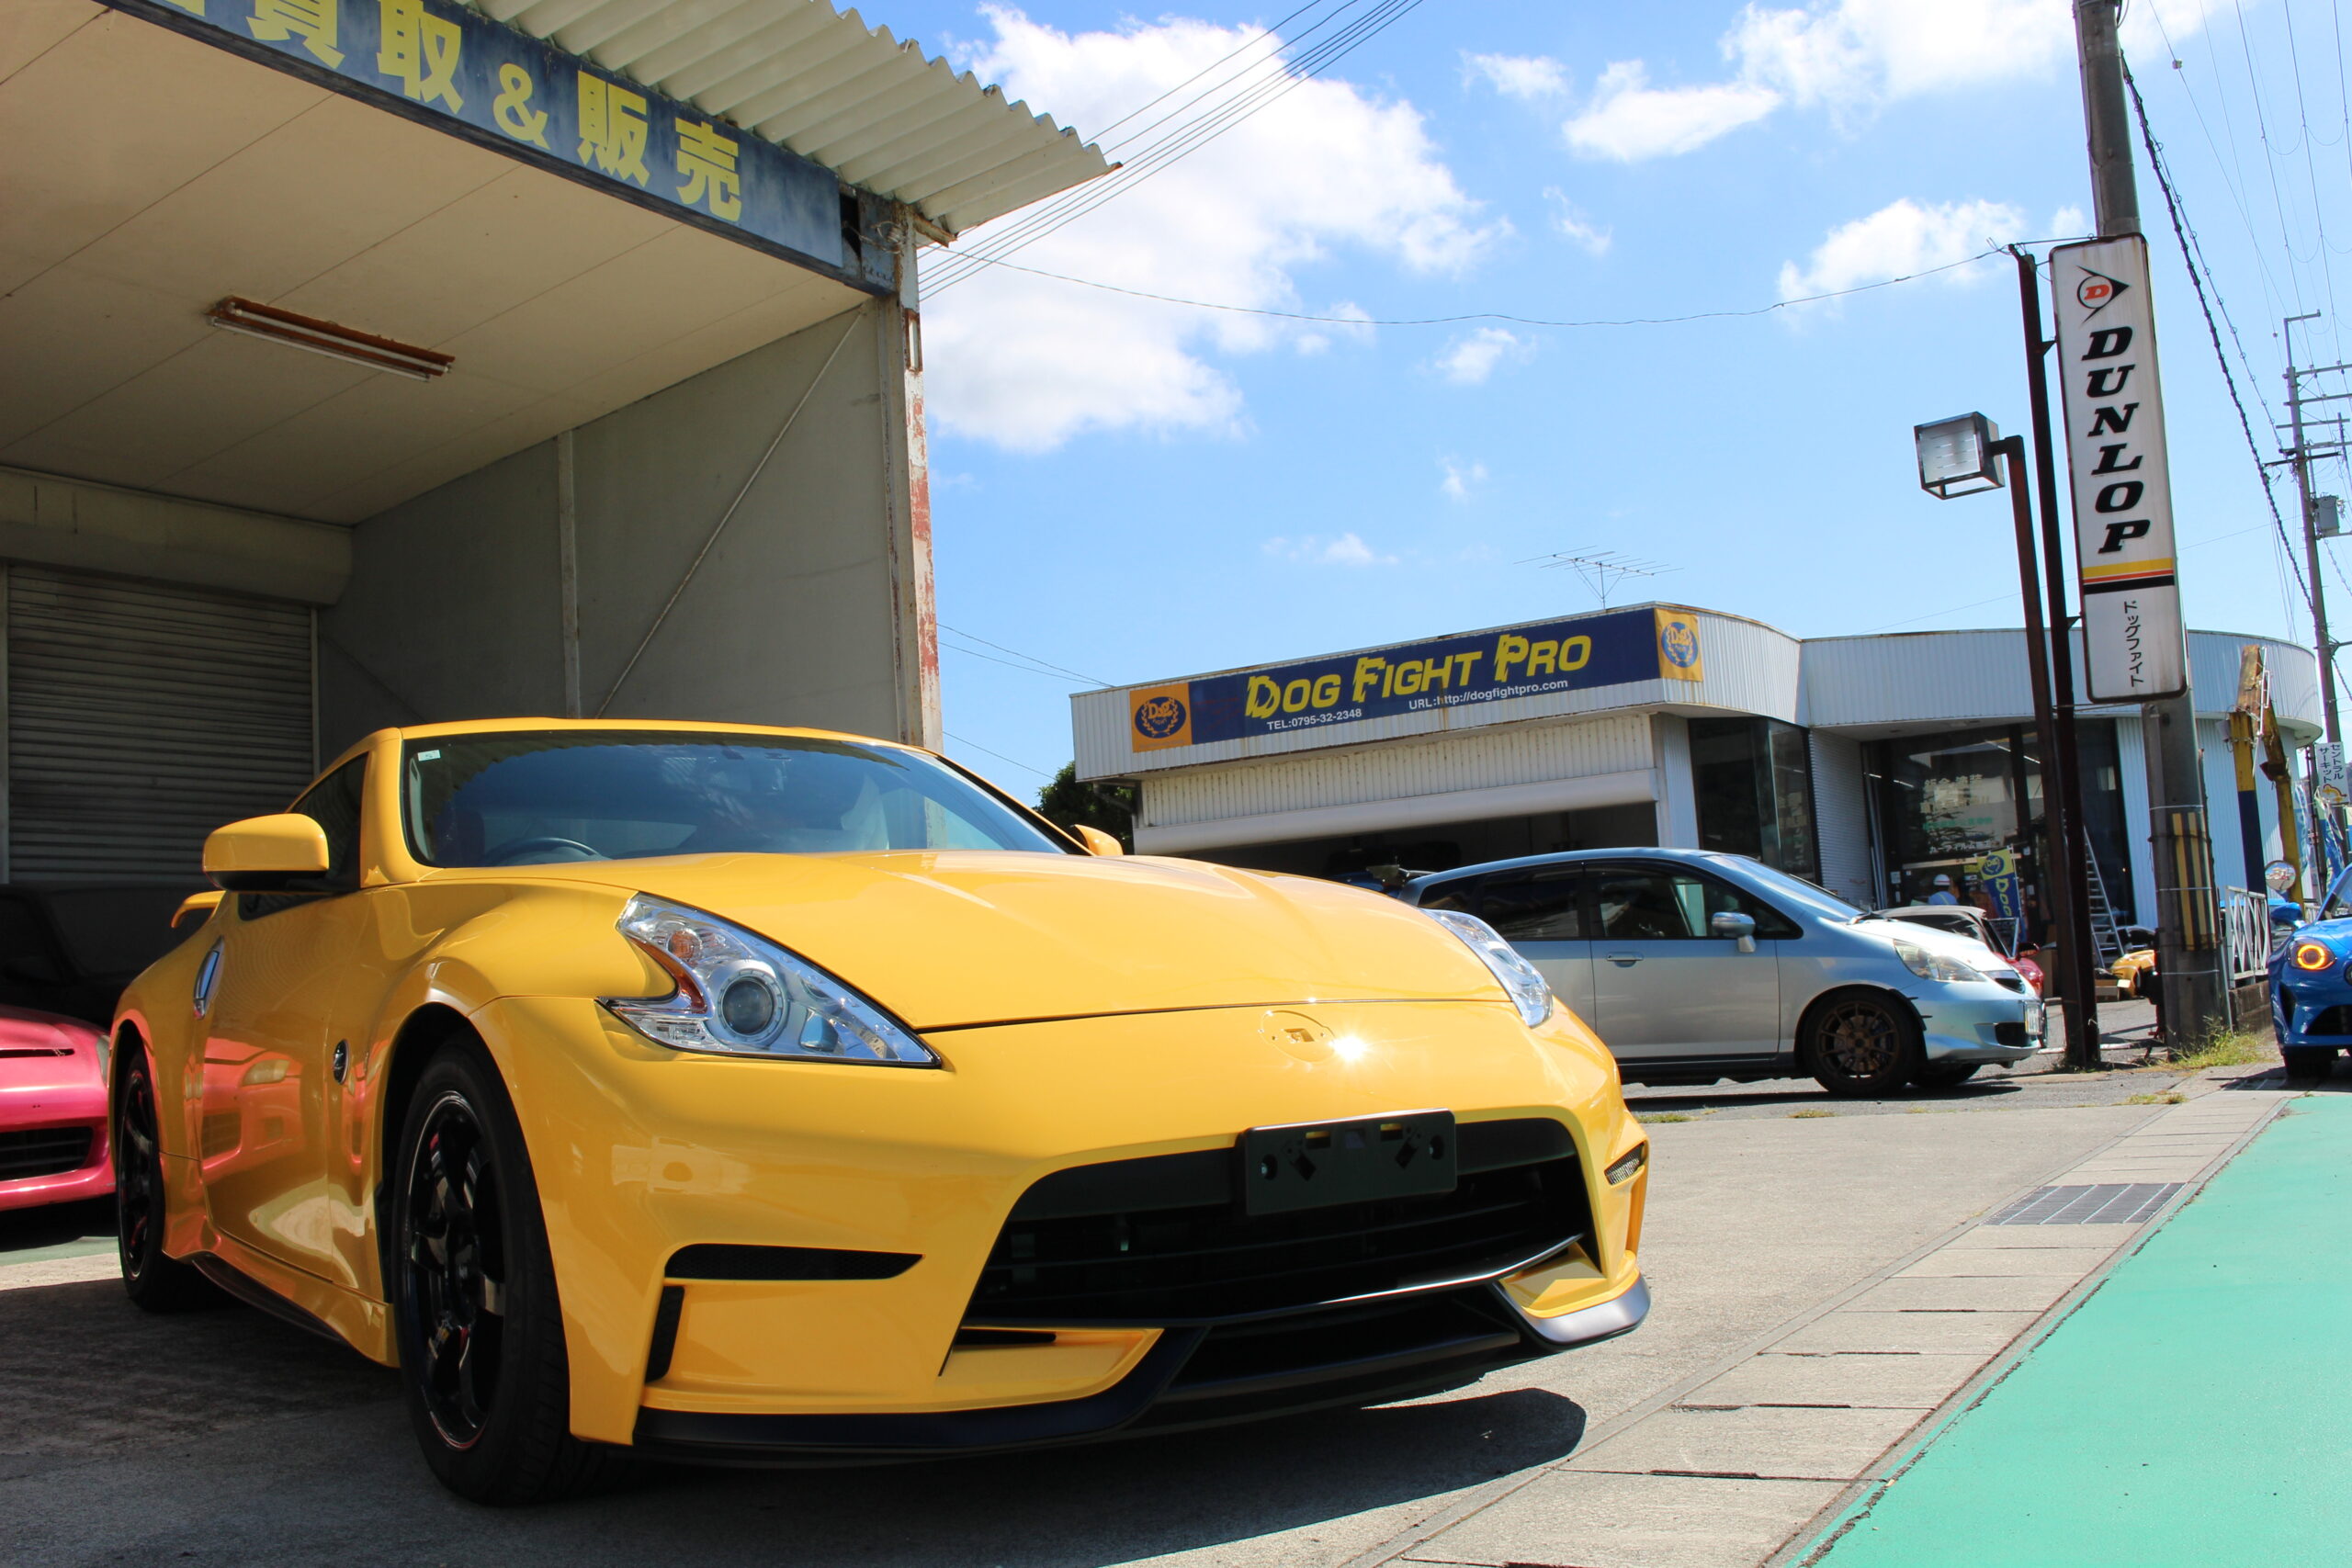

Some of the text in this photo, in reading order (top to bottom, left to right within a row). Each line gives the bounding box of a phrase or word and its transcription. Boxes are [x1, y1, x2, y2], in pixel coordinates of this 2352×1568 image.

[164, 0, 742, 222] 買取&販売
[2081, 325, 2151, 555] DUNLOP
[1244, 633, 1592, 719] DOG FIGHT PRO
[1266, 708, 1363, 731] TEL:0795-32-2348
[2319, 747, 2333, 784] サーキット
[2330, 743, 2344, 781] セントラル
